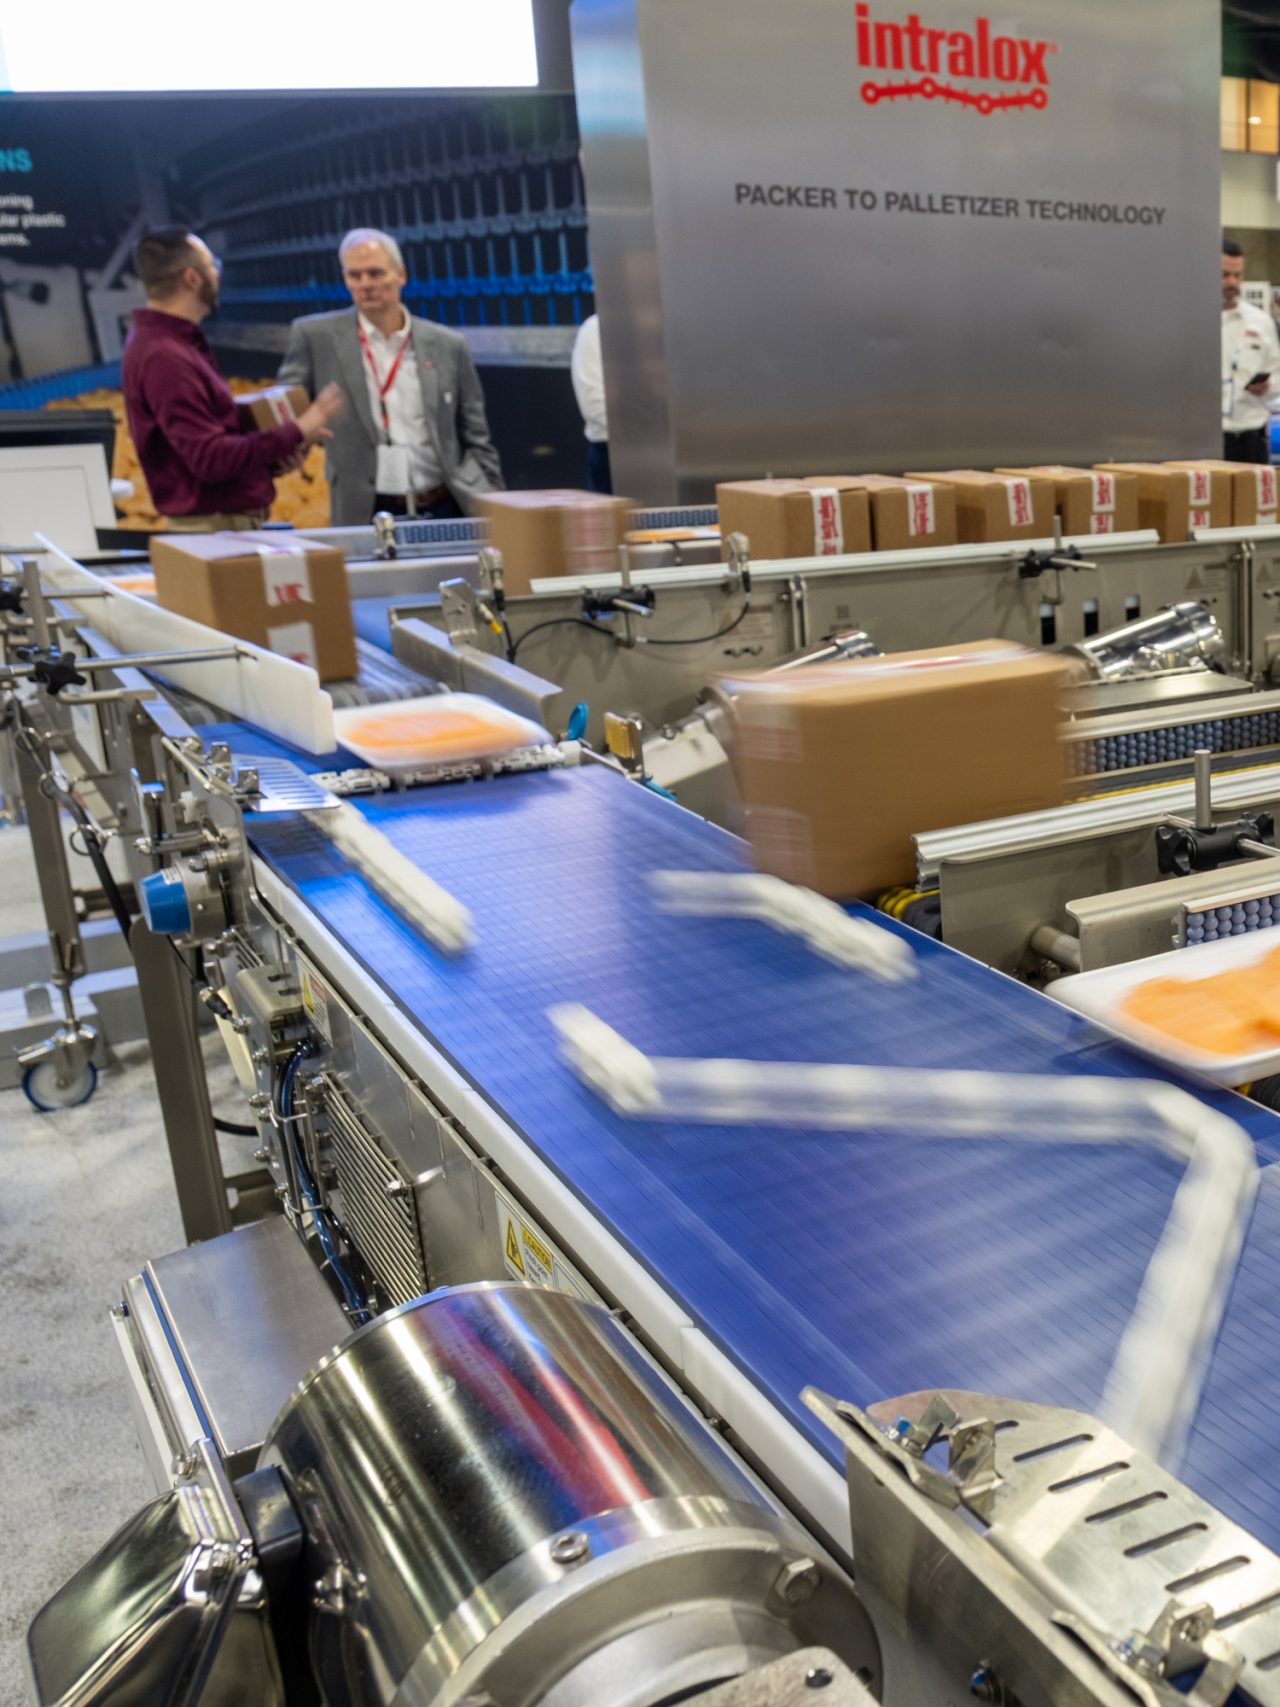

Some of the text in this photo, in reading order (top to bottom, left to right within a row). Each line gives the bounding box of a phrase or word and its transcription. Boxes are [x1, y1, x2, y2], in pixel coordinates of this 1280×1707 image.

[855, 2, 1049, 86] intralox
[734, 183, 1166, 226] PACKER TO PALLETIZER TECHNOLOGY
